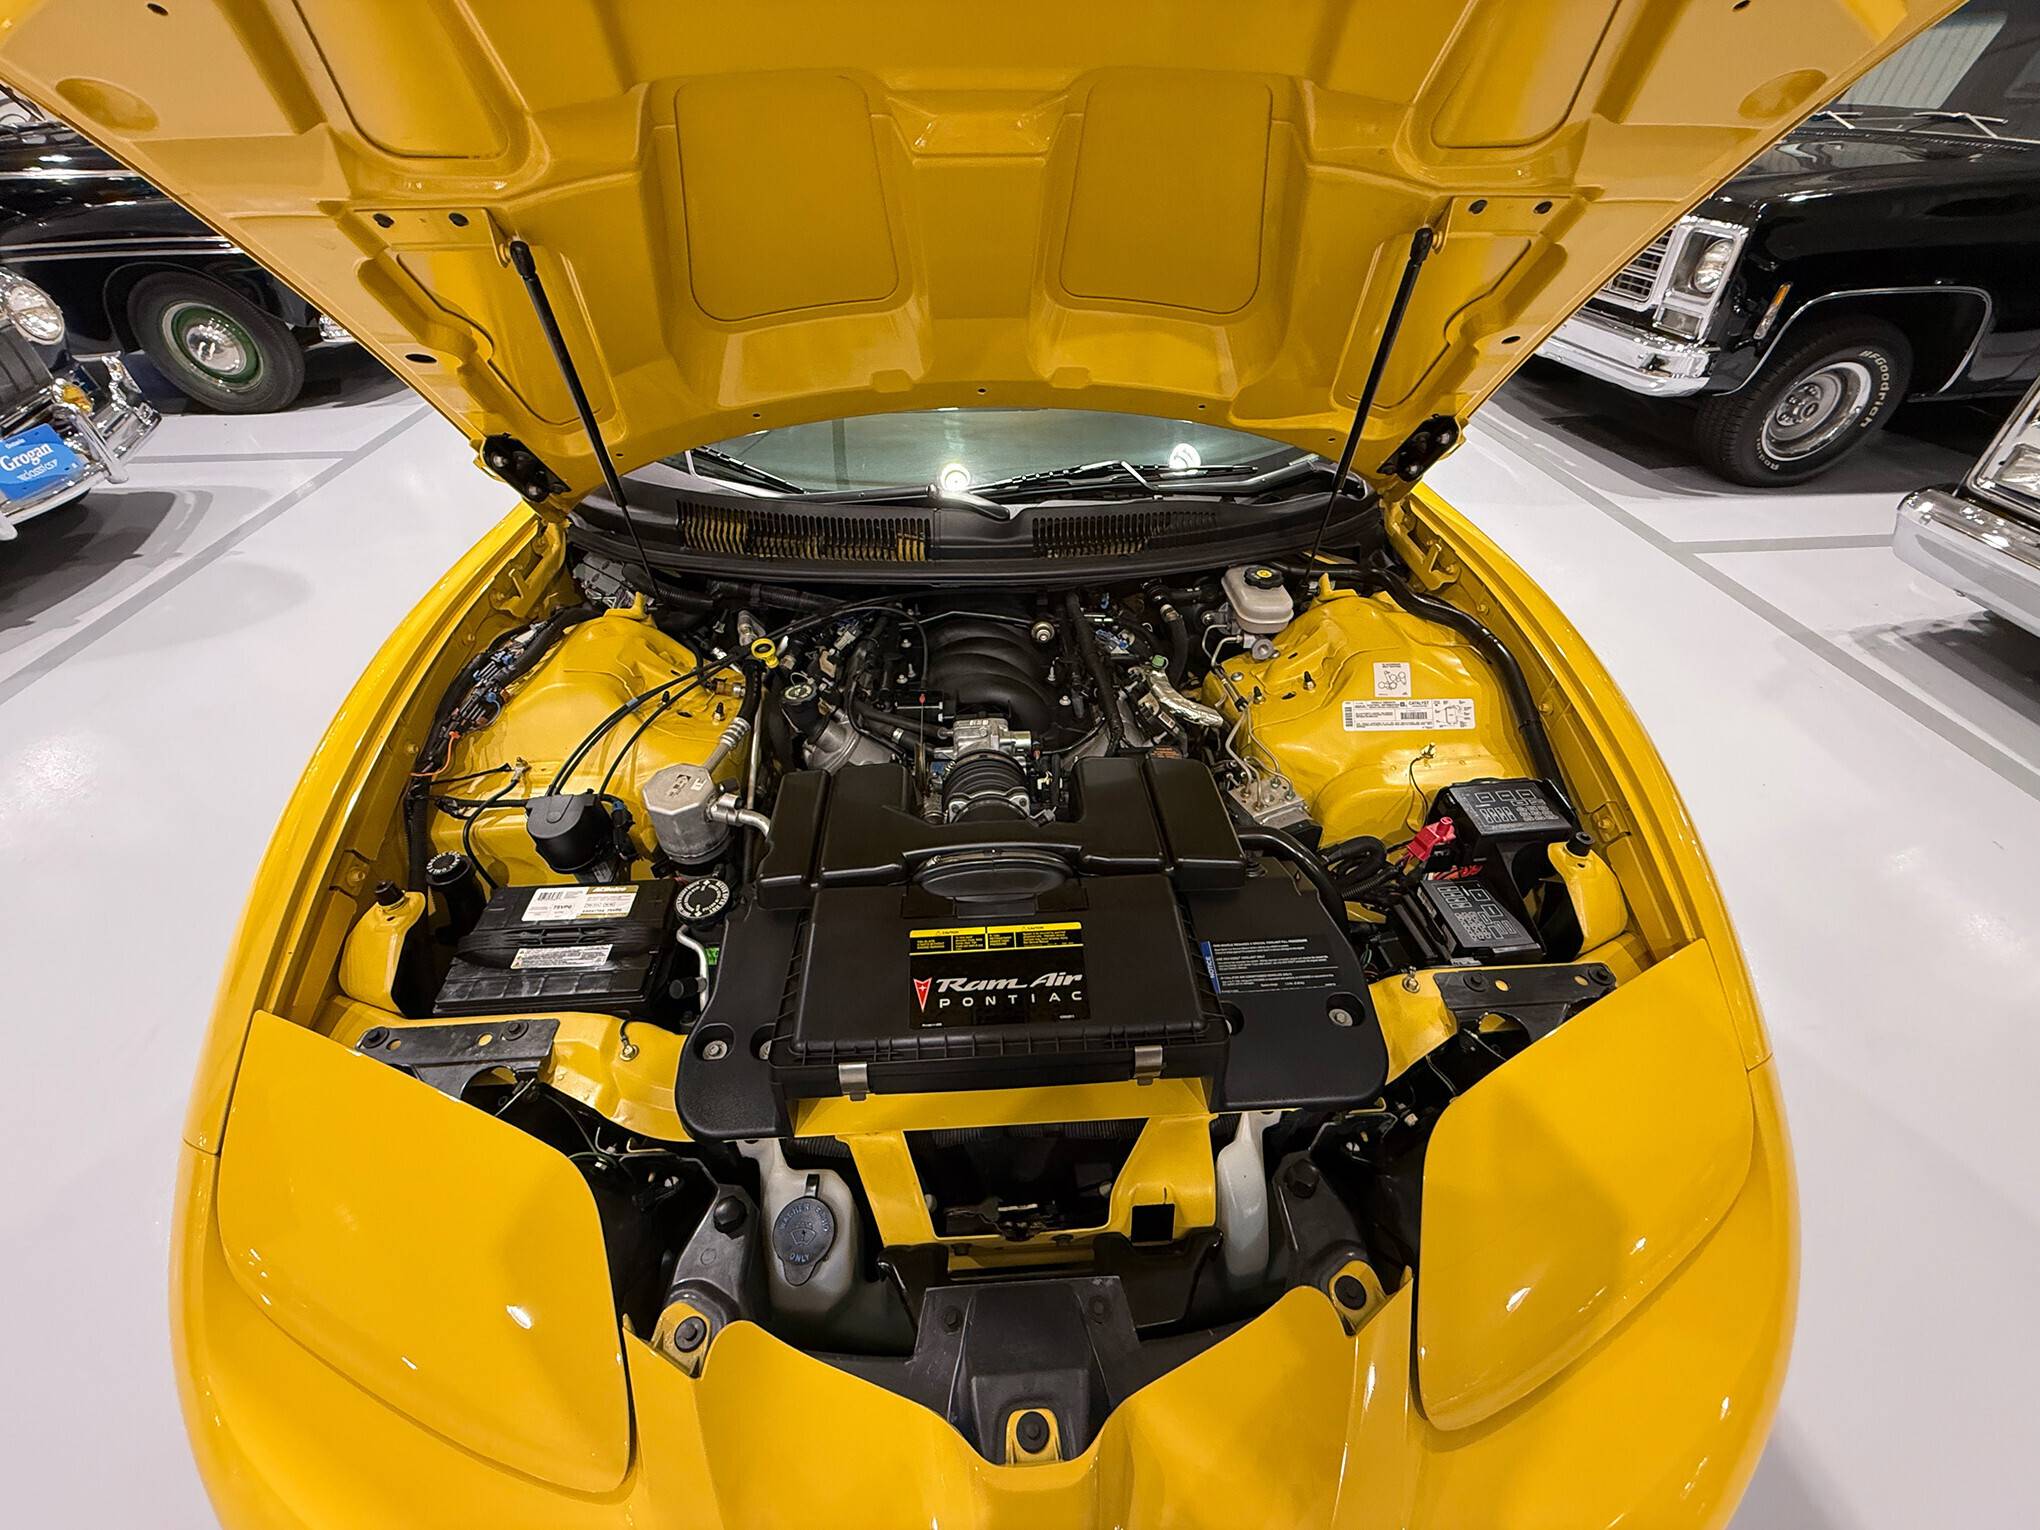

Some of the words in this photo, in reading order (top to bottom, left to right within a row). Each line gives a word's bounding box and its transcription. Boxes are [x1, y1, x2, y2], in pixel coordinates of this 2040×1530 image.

[0, 443, 54, 471] Grogan
[1206, 956, 1215, 979] NOTICE
[936, 977, 1028, 993] Ram
[1029, 971, 1083, 988] Air
[939, 991, 1082, 1009] PONTIAC
[789, 1253, 810, 1262] ONLY
